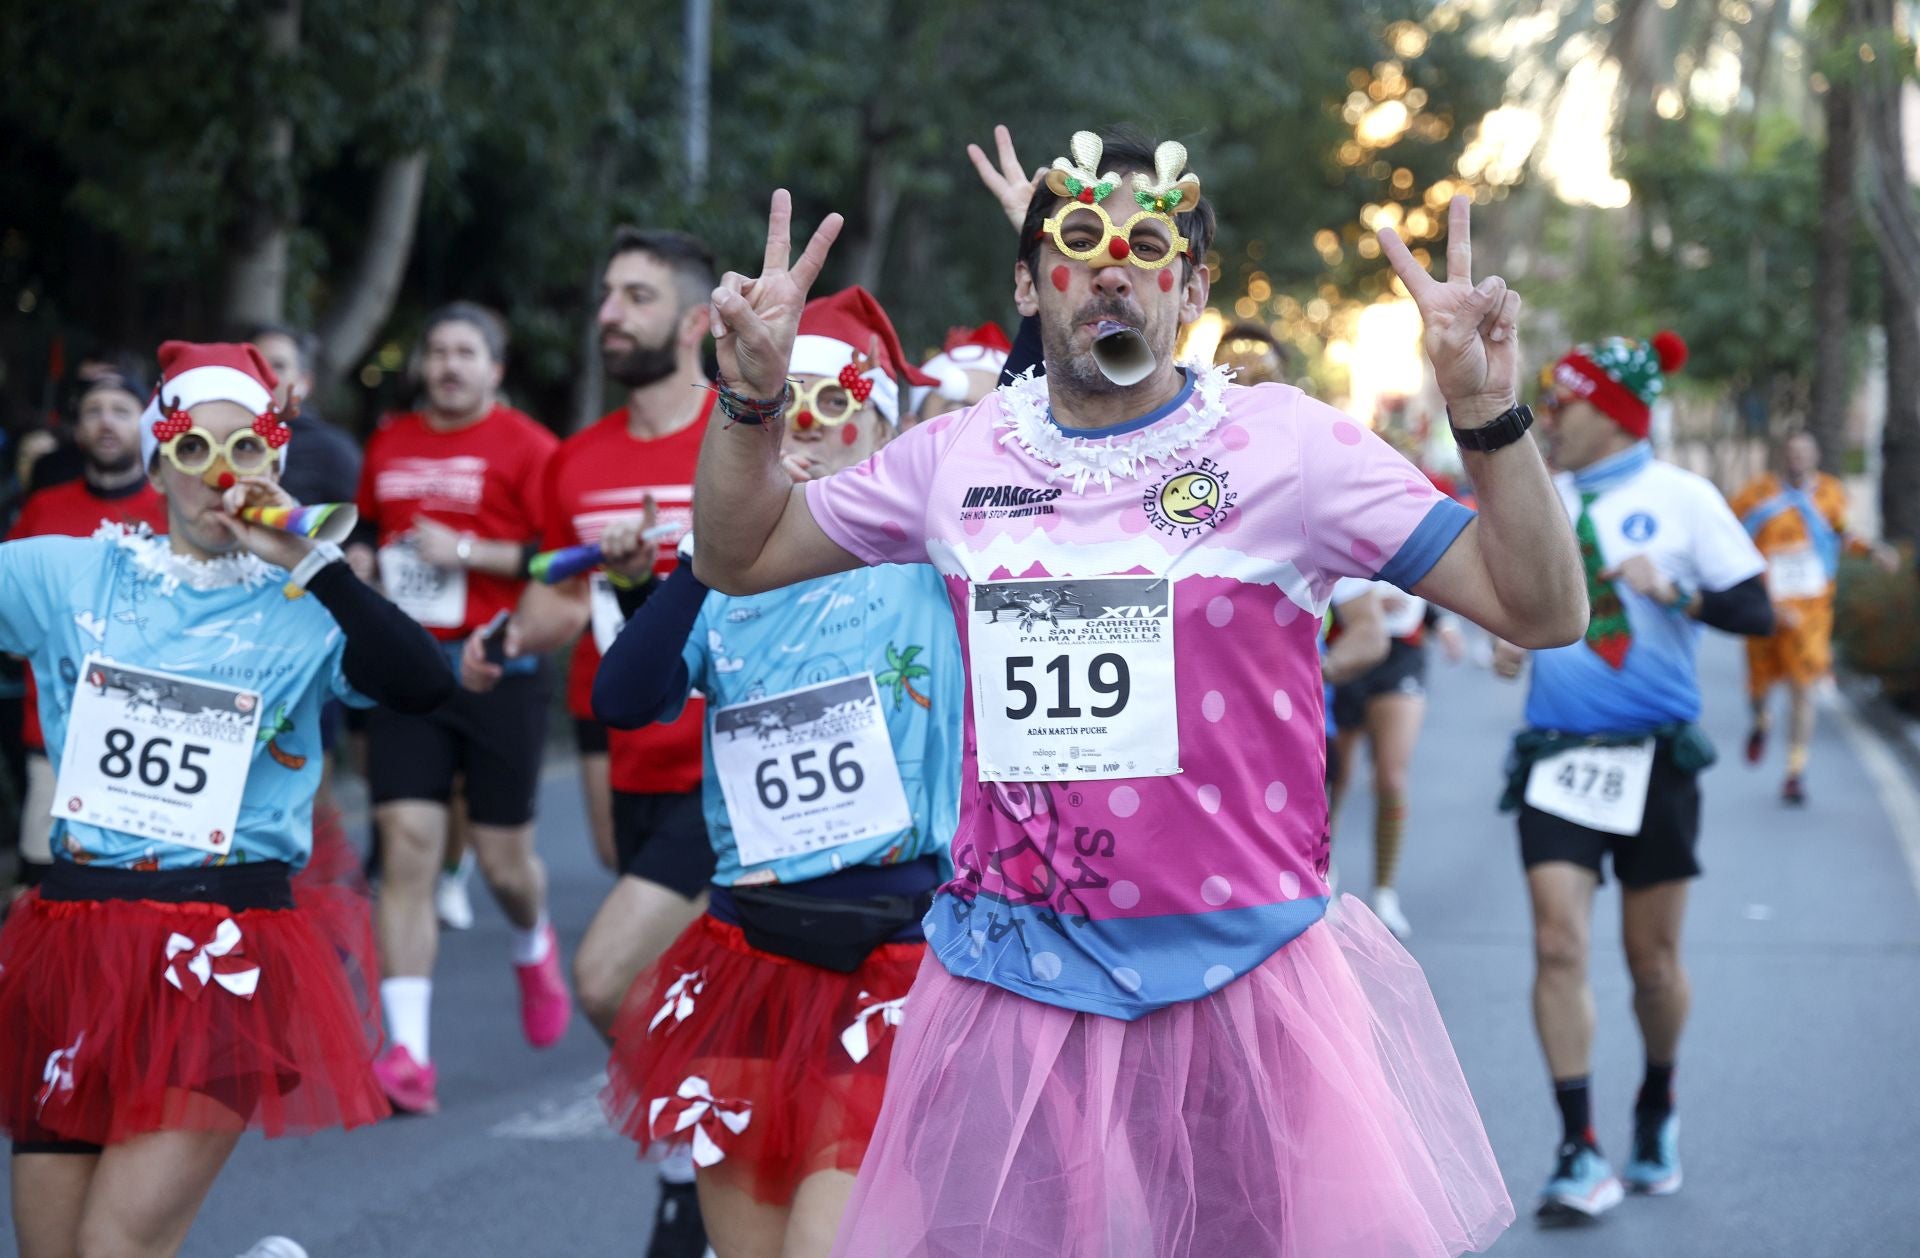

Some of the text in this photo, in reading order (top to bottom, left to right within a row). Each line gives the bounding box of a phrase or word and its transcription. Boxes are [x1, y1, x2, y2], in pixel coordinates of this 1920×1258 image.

[960, 511, 973, 521] 24H
[972, 511, 987, 520] NON
[988, 510, 1008, 519] STOP
[1143, 482, 1178, 536] LENGUA
[1205, 492, 1238, 529] SACA
[1181, 526, 1202, 539] LA
[1097, 604, 1167, 619] XIV
[1081, 626, 1161, 635] SILVESTRE
[1086, 619, 1161, 628] CARRERA
[1020, 633, 1161, 643] PALMA PALMILLA
[1006, 652, 1131, 720] 519
[1048, 726, 1078, 735] MARTÍN
[1080, 727, 1108, 735] PUCHE
[99, 728, 211, 795] 865
[755, 741, 865, 810] 656
[1557, 761, 1625, 801] 478
